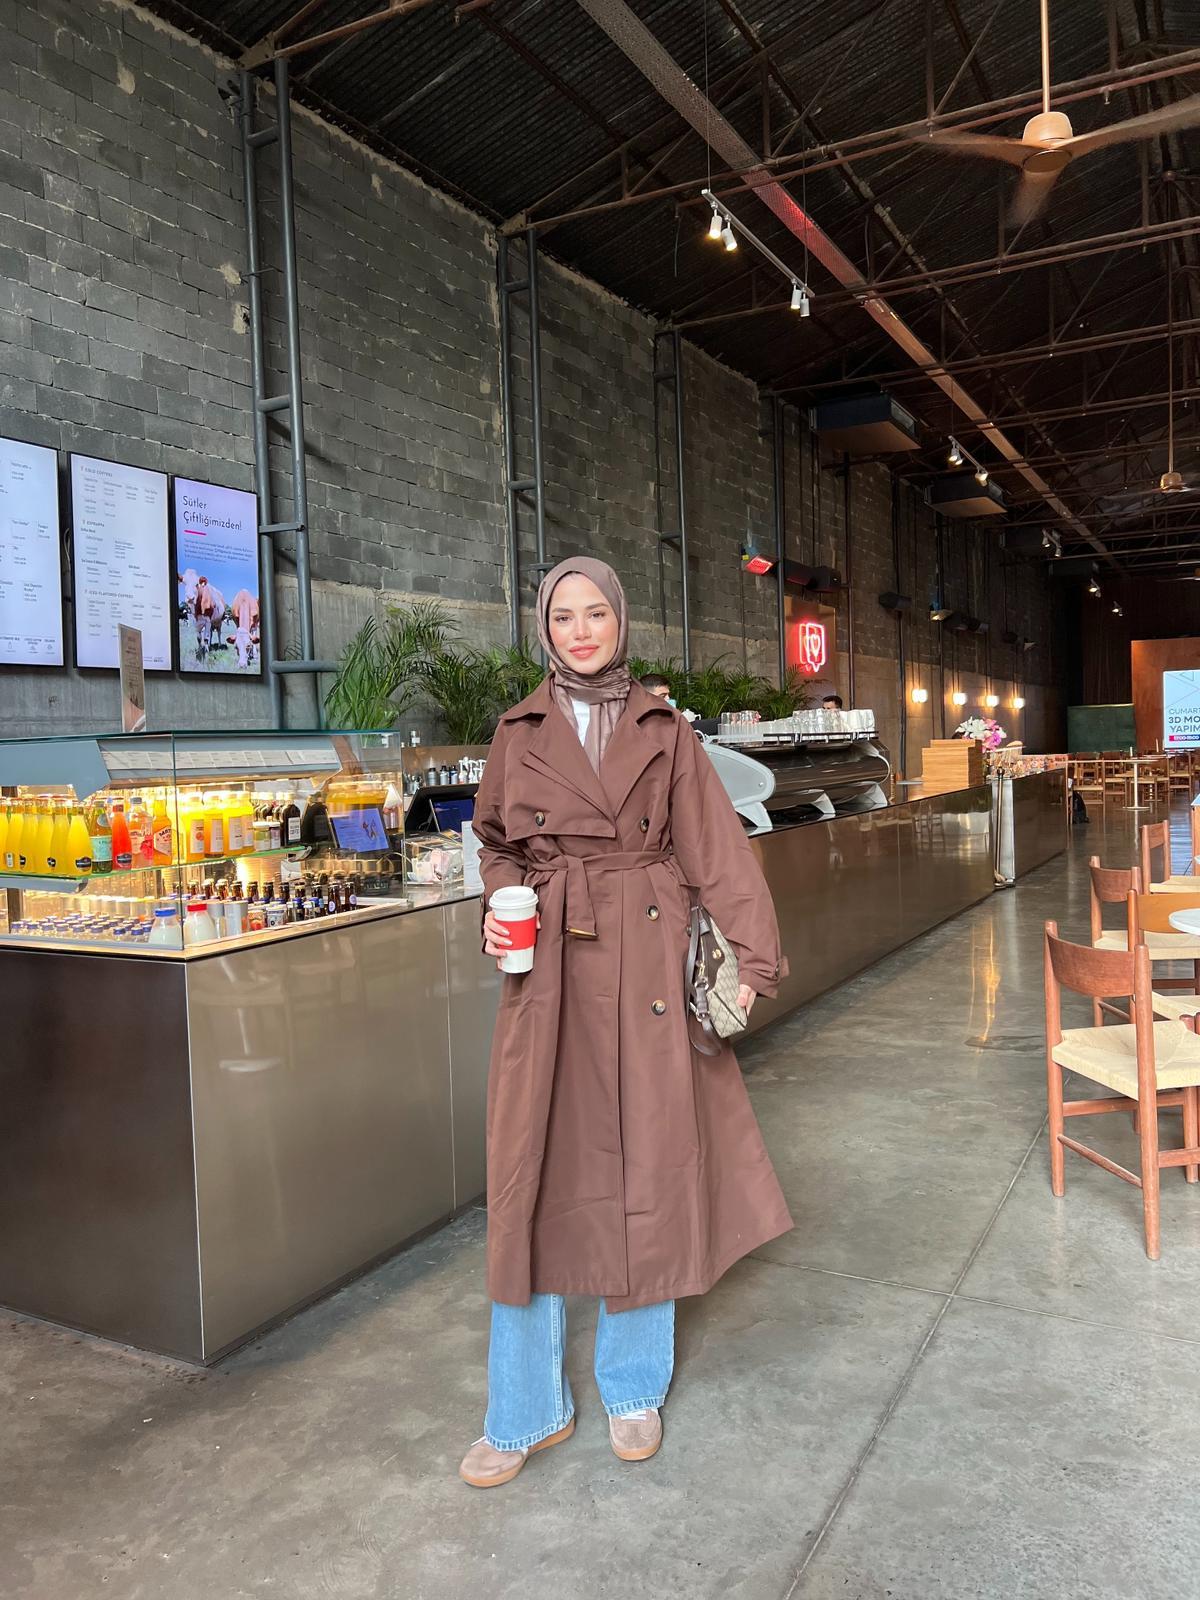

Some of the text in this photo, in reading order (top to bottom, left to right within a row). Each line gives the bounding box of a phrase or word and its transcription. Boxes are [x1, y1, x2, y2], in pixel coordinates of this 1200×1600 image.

[182, 495, 208, 509] Sütler
[183, 510, 242, 530] Çiftliğimizden!
[1168, 715, 1200, 724] 3D MO
[1169, 724, 1200, 733] YAPIM
